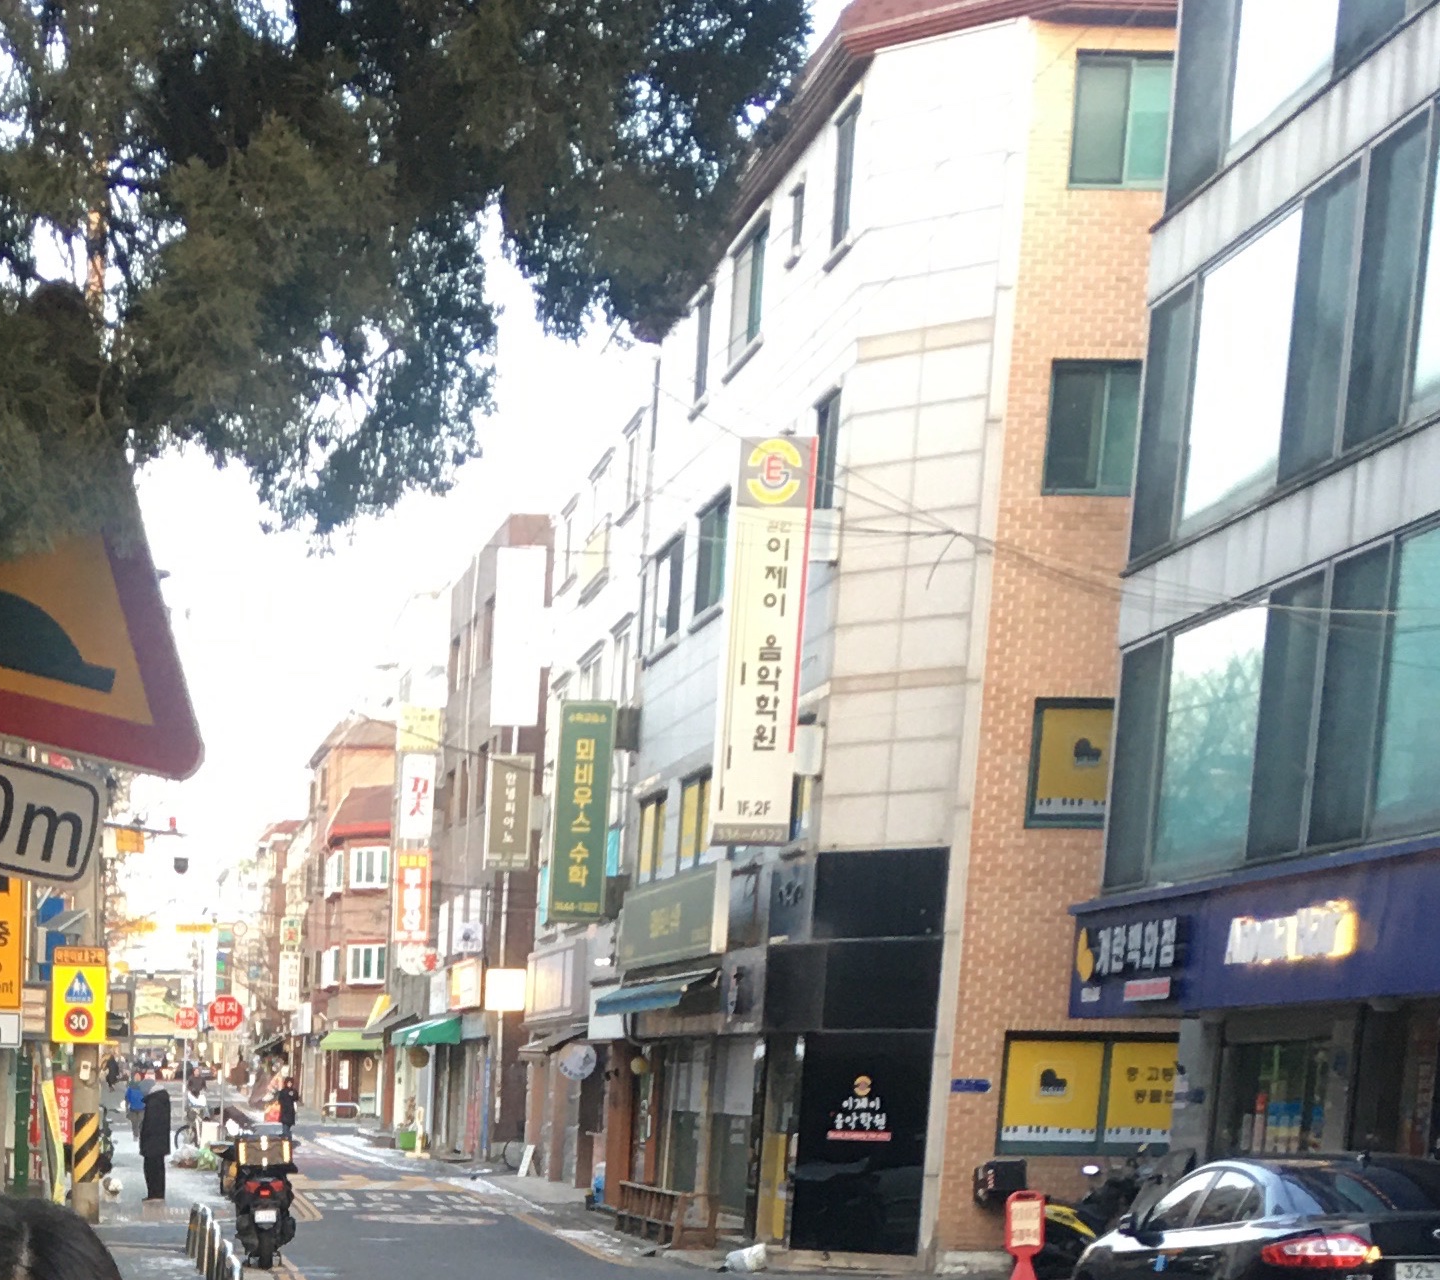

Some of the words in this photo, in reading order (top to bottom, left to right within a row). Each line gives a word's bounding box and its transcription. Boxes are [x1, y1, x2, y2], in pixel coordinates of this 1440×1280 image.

[763, 537, 790, 617] 이제이
[752, 634, 782, 751] 음악학원
[571, 738, 596, 833] 뫼비우스
[568, 841, 590, 888] 수학
[69, 1014, 89, 1030] 30
[214, 1016, 238, 1026] STOP
